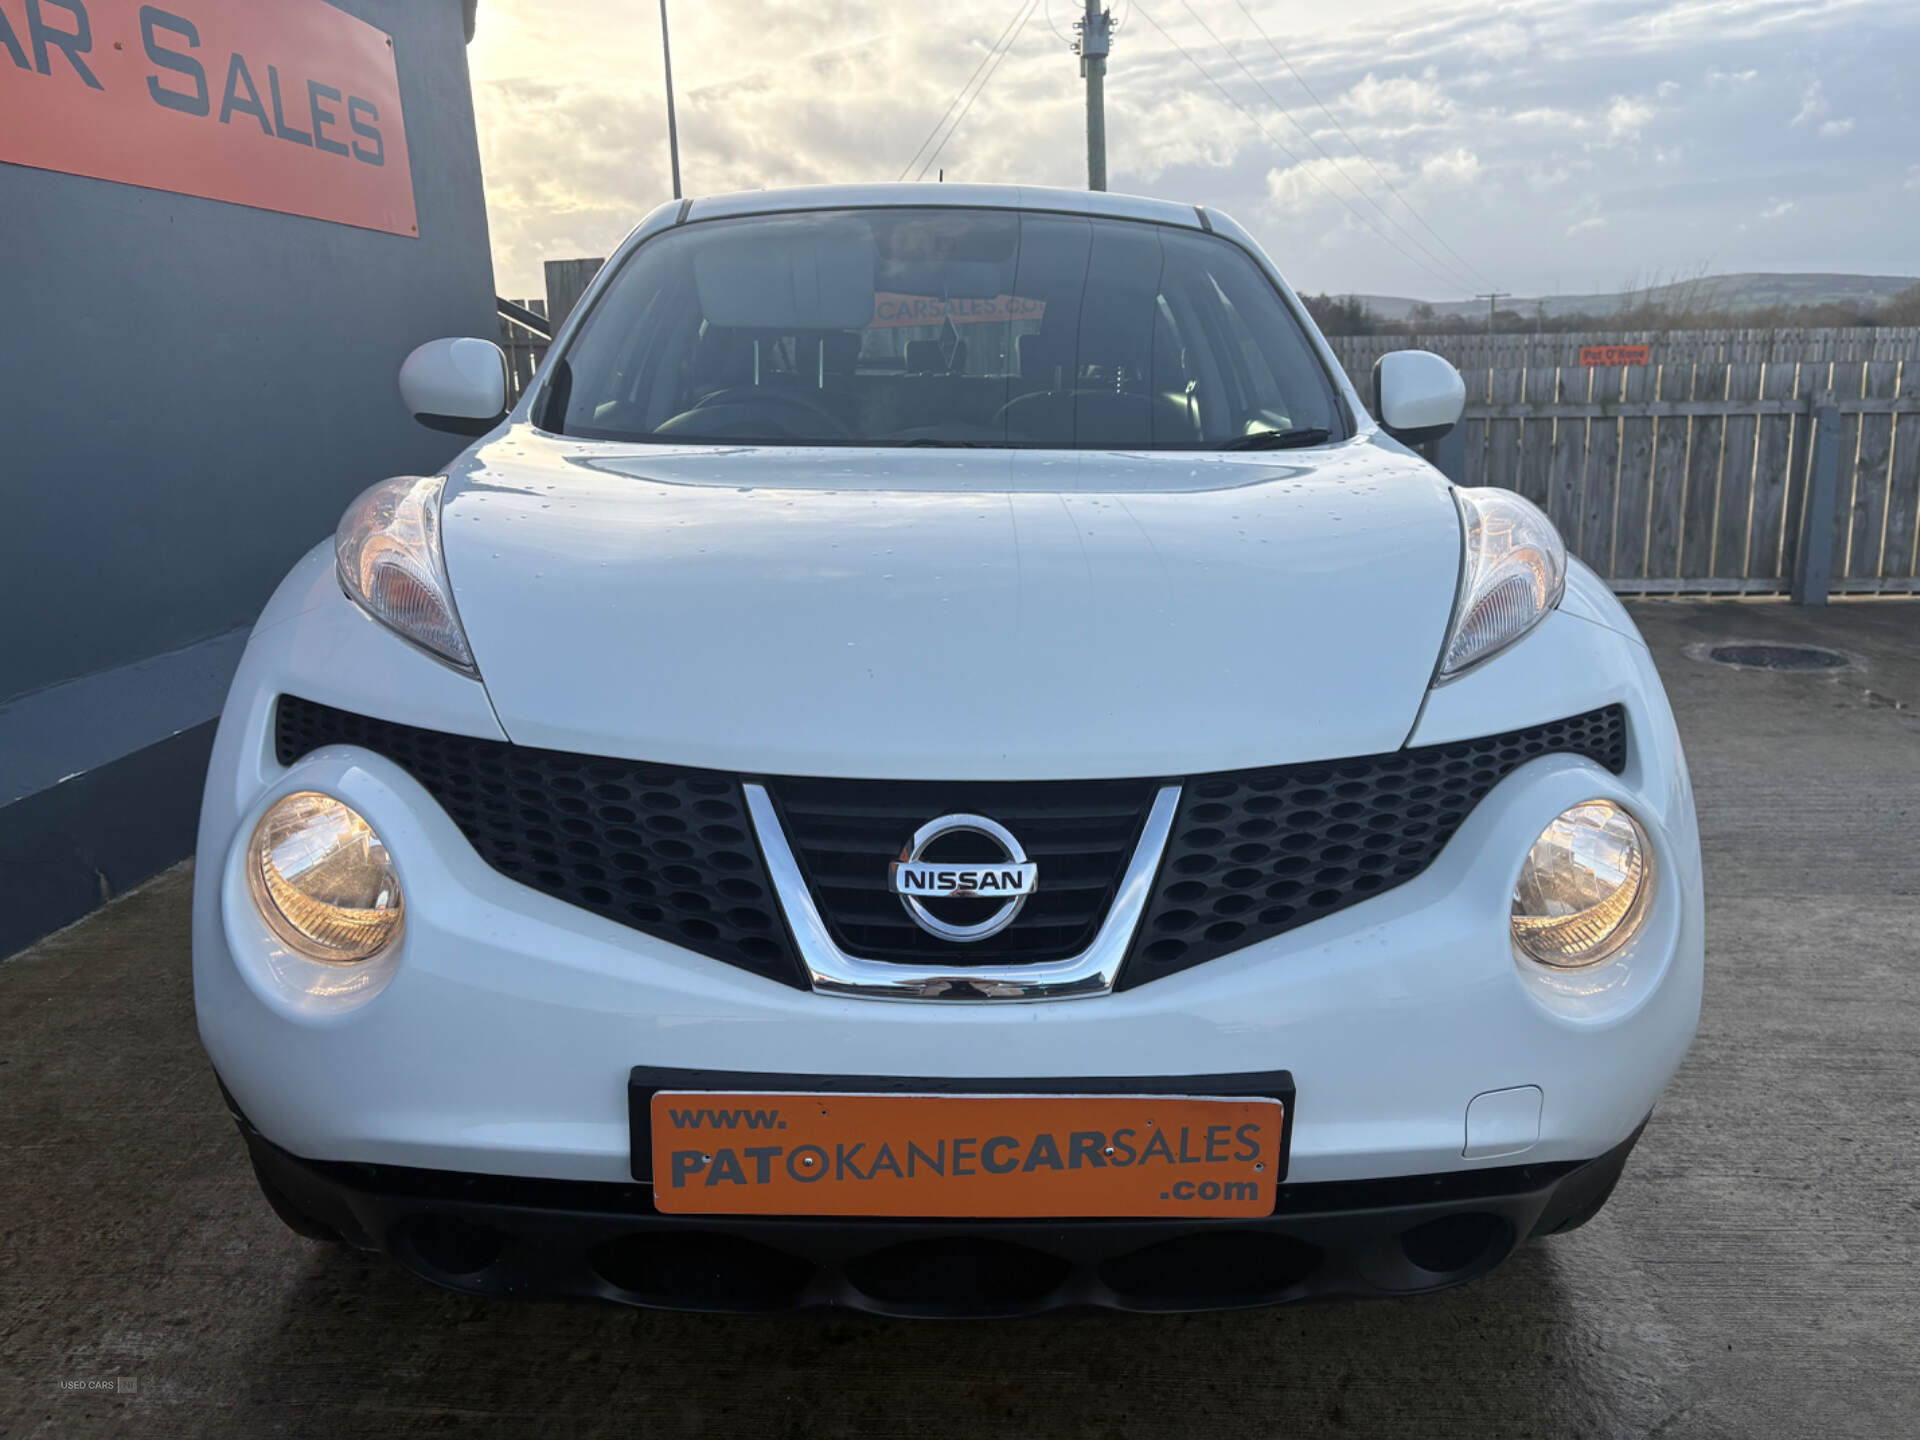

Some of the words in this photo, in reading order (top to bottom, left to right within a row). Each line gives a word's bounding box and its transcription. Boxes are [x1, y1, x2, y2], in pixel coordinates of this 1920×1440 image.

[139, 4, 385, 167] SALES
[904, 870, 1024, 891] NISSAN
[669, 1109, 787, 1130] www.
[1160, 1181, 1259, 1201] .com
